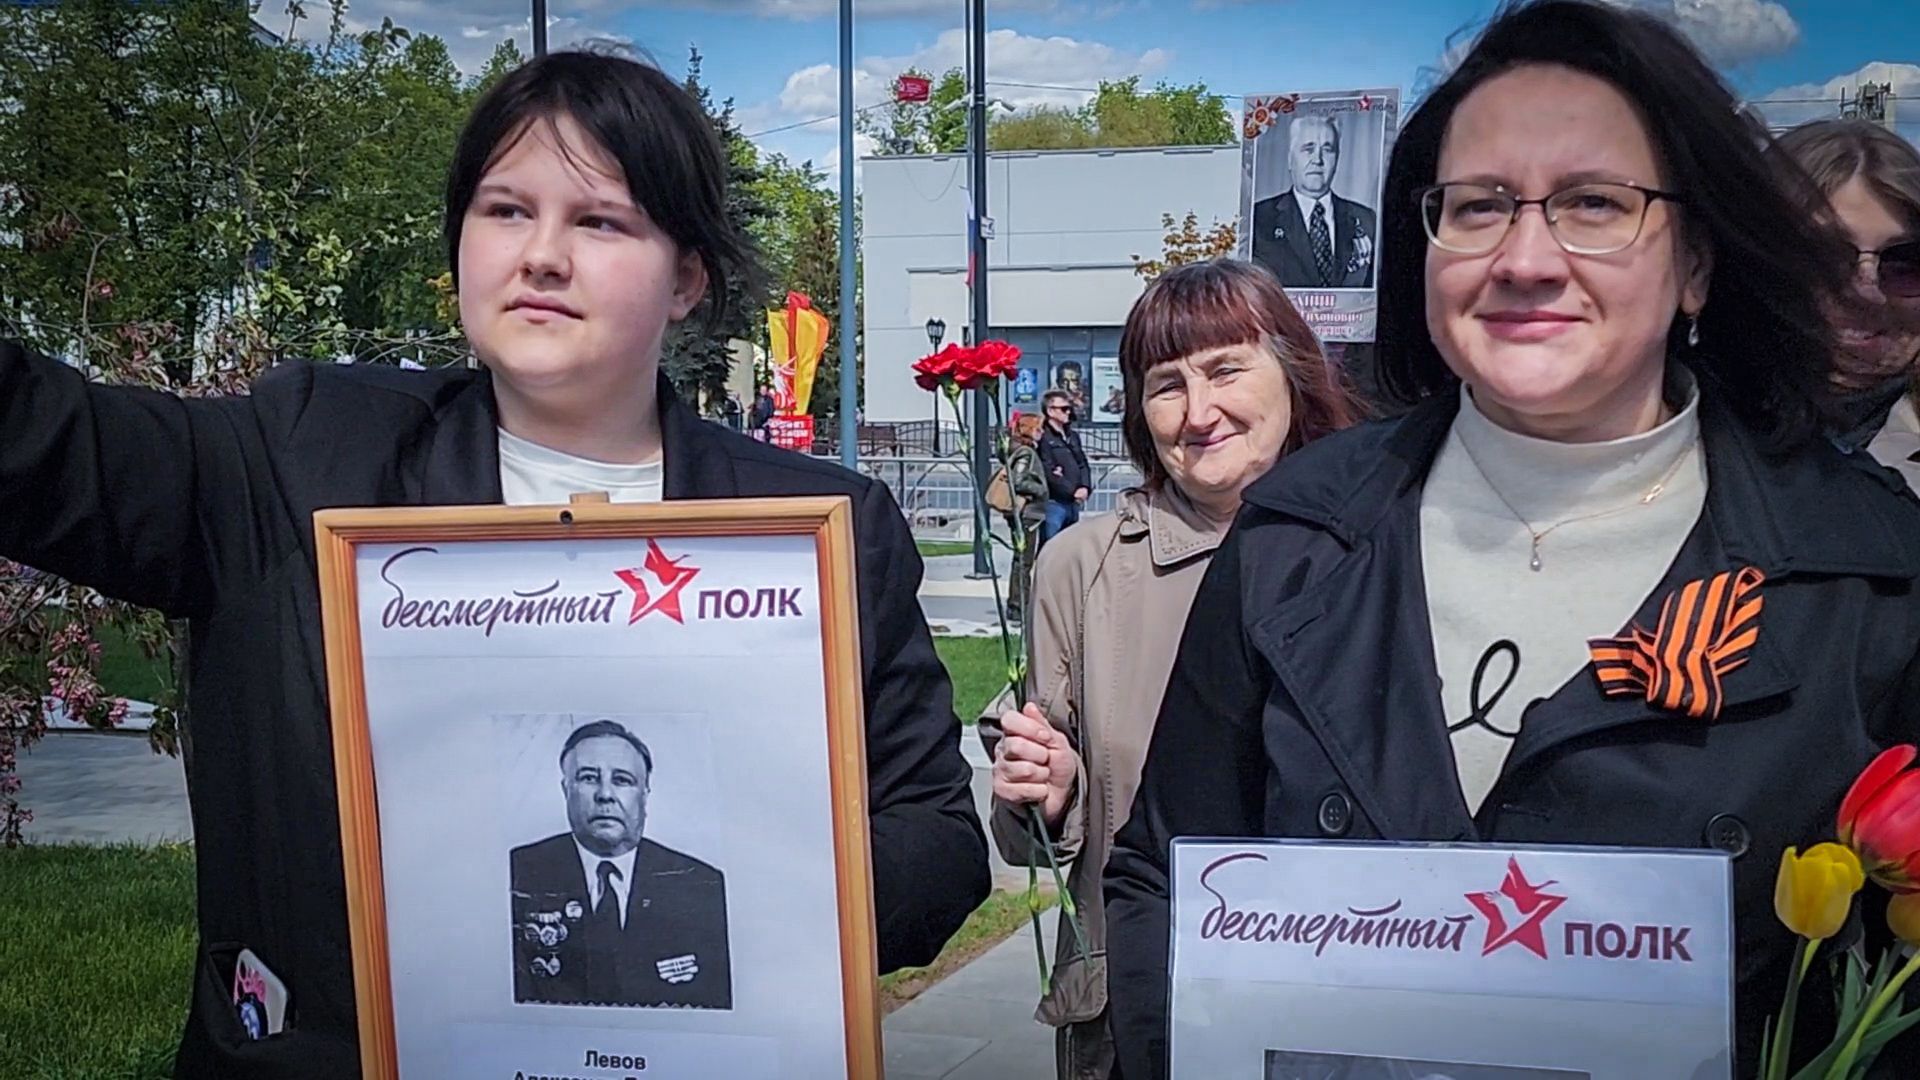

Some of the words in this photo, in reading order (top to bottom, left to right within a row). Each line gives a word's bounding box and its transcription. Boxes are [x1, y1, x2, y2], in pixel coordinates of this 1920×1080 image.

[698, 587, 803, 620] ПОЛК
[1565, 922, 1693, 962] ПОЛК
[584, 1050, 646, 1070] Левов
